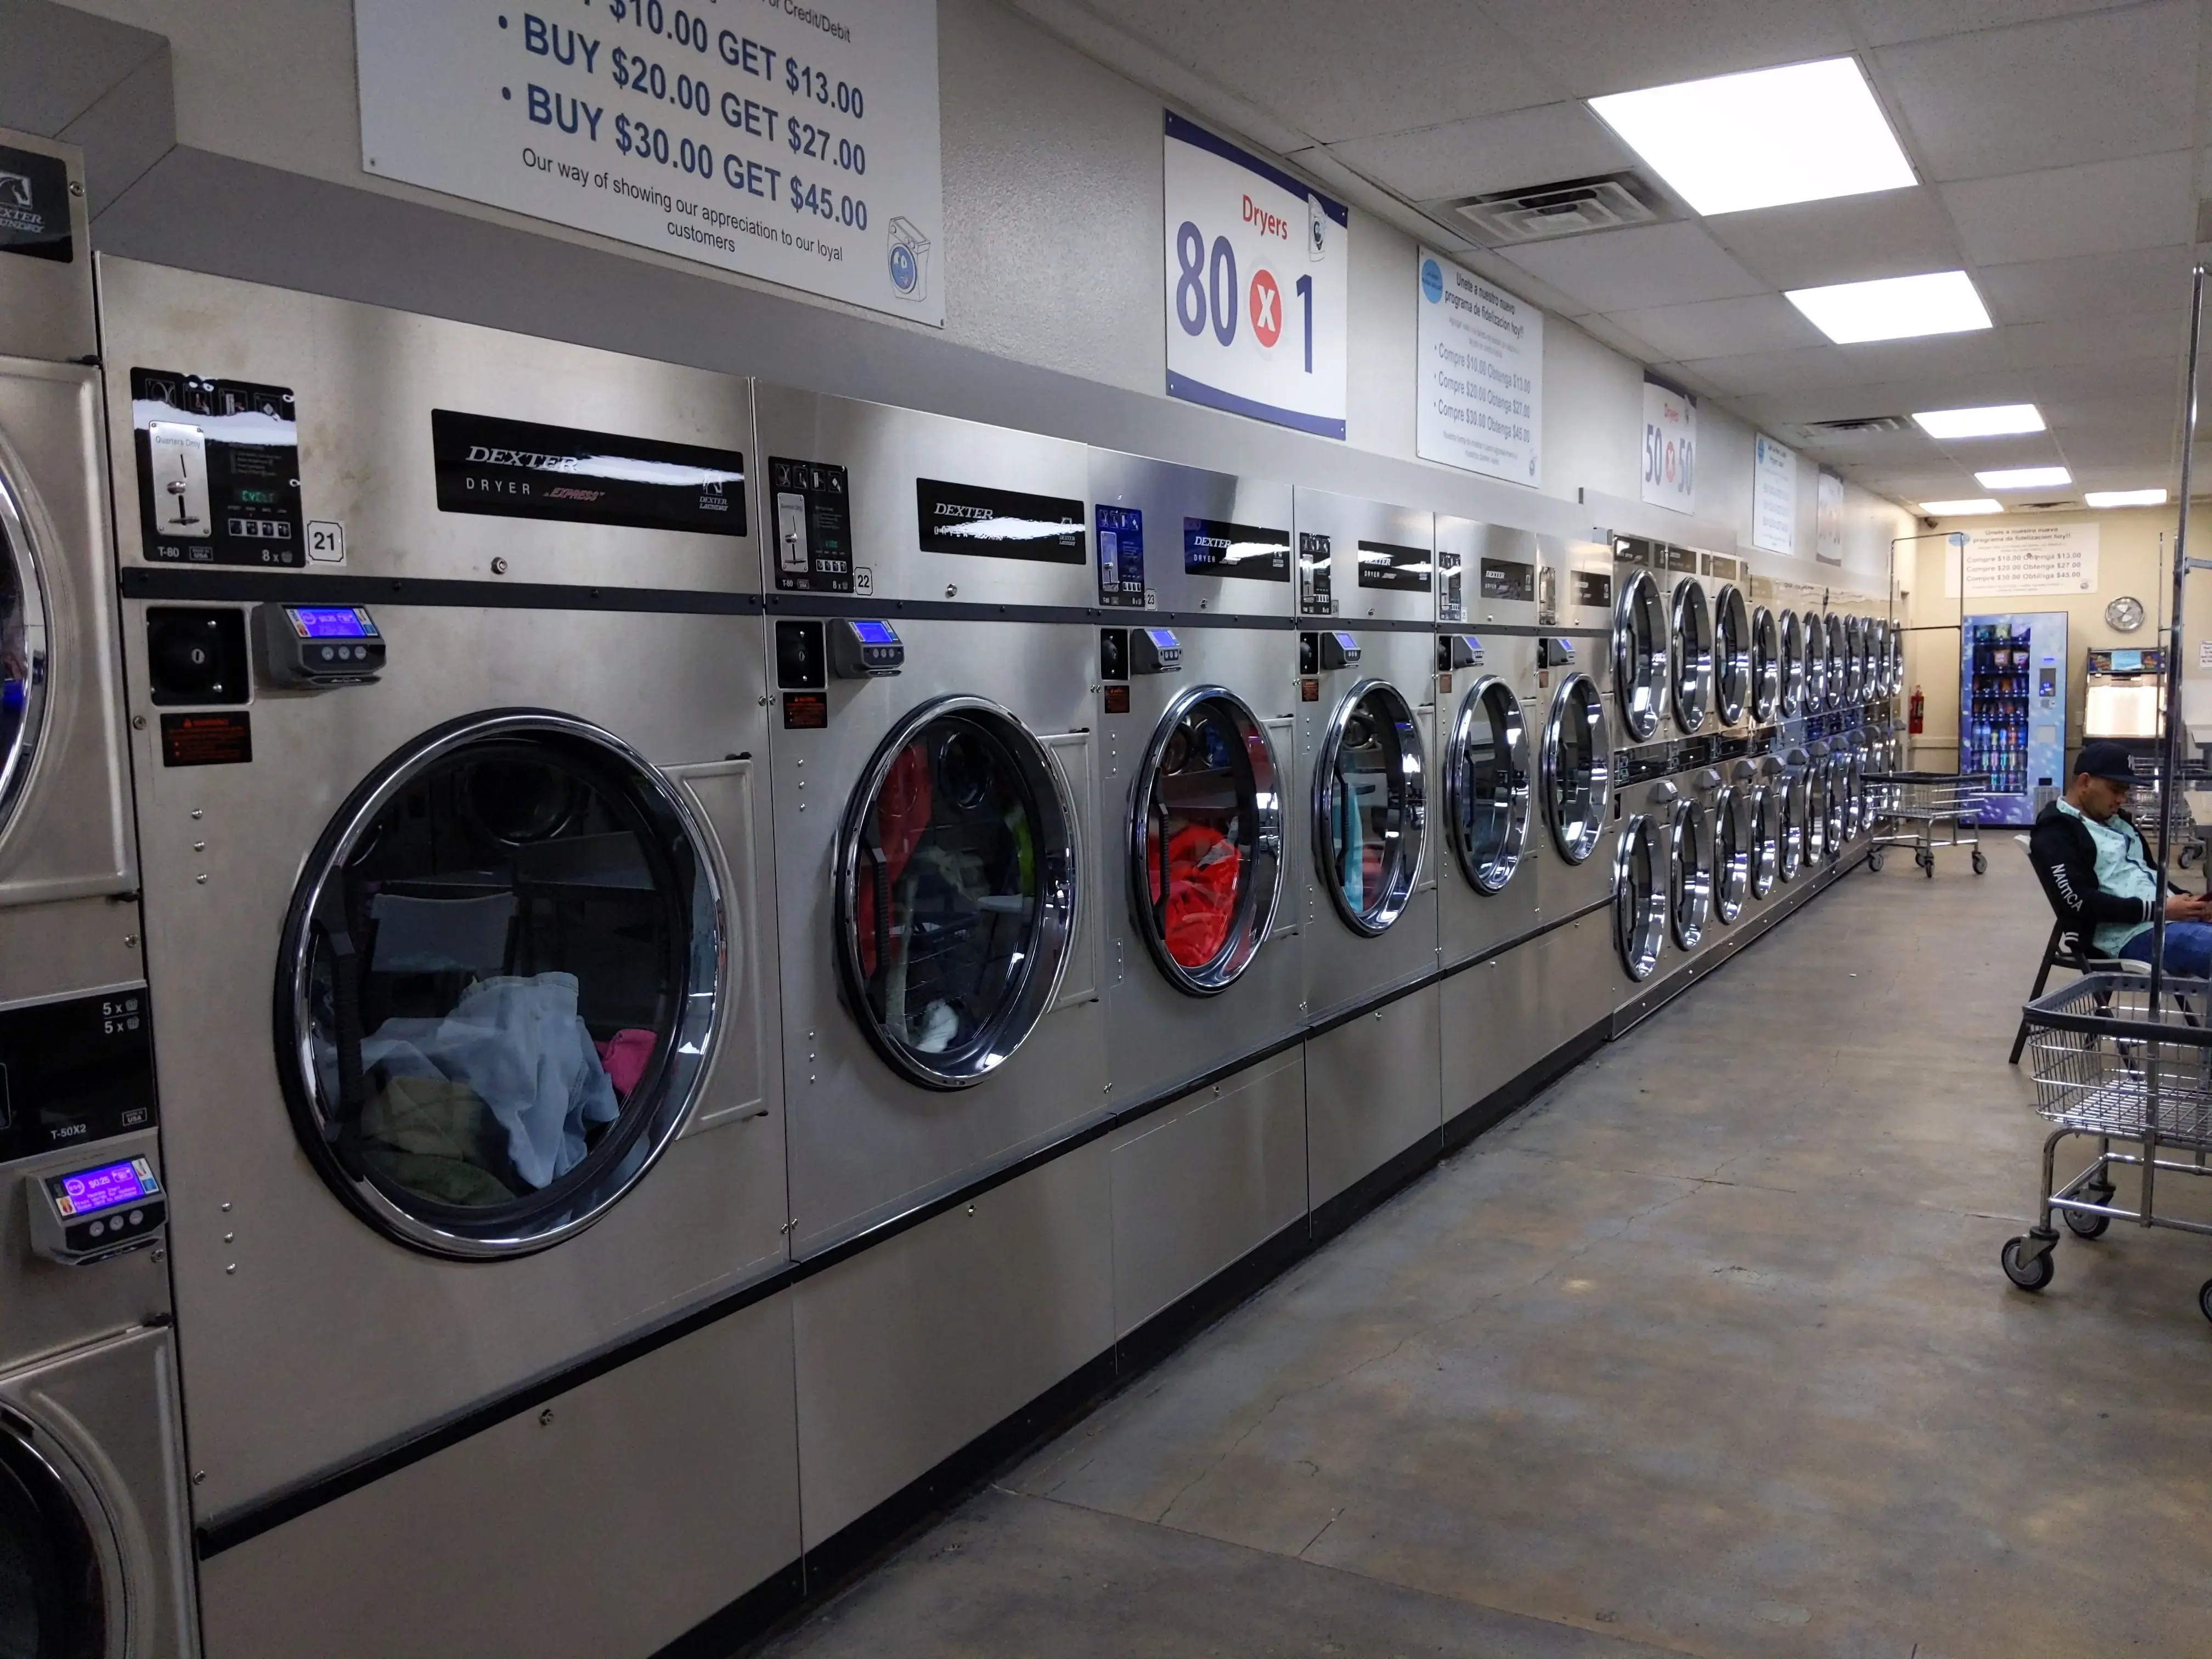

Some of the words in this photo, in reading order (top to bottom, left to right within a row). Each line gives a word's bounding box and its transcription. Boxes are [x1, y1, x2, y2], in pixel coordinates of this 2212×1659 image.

[784, 0, 851, 43] Credit/Debit
[719, 30, 776, 82] GET
[786, 55, 864, 119] $13.00
[524, 13, 600, 74] BUY
[612, 46, 710, 116] $20.00
[721, 92, 778, 142] GET
[788, 116, 865, 176] $27.00
[528, 83, 603, 142] BUY
[615, 112, 713, 179] $30.00
[724, 154, 781, 201] GET
[791, 174, 867, 231] $45.00
[523, 148, 553, 172] Our
[558, 162, 589, 187] way
[594, 172, 608, 189] of
[613, 178, 671, 212] showing
[676, 199, 698, 216] our
[702, 206, 777, 242] appreciation
[782, 229, 792, 245] to
[796, 236, 815, 252] our
[817, 239, 843, 261] loyal
[1242, 194, 1288, 240] Dryers
[668, 222, 735, 252] customers
[1176, 221, 1238, 347] 80
[1296, 274, 1313, 374] 1
[1444, 290, 1472, 313] programa
[1474, 301, 1481, 317] de
[1474, 285, 1477, 295] a
[1479, 287, 1499, 306] nuestro
[1439, 342, 1465, 367] Compre
[1466, 354, 1486, 376] $10.00
[1438, 370, 1464, 395] Compre
[1466, 381, 1486, 402] $20.00
[1438, 398, 1464, 422] Compre
[1466, 408, 1486, 428] $30.00
[466, 445, 579, 472] DEXTER
[1645, 424, 1662, 486] 50
[1678, 438, 1692, 496] 50
[466, 477, 530, 495] DRYER
[699, 496, 728, 505] DEXTER
[934, 503, 993, 520] DEXTER
[157, 546, 179, 558] T-80
[313, 532, 335, 551] 21
[1194, 536, 1232, 549] DEXTER
[262, 549, 270, 562] 8
[1194, 554, 1215, 563] DRYER
[857, 574, 870, 588] 22
[1147, 594, 1155, 605] 23
[2051, 864, 2083, 912] NAUTICA
[103, 1002, 112, 1015] 5
[104, 1021, 114, 1034] 5
[50, 1124, 87, 1140] T-50X2
